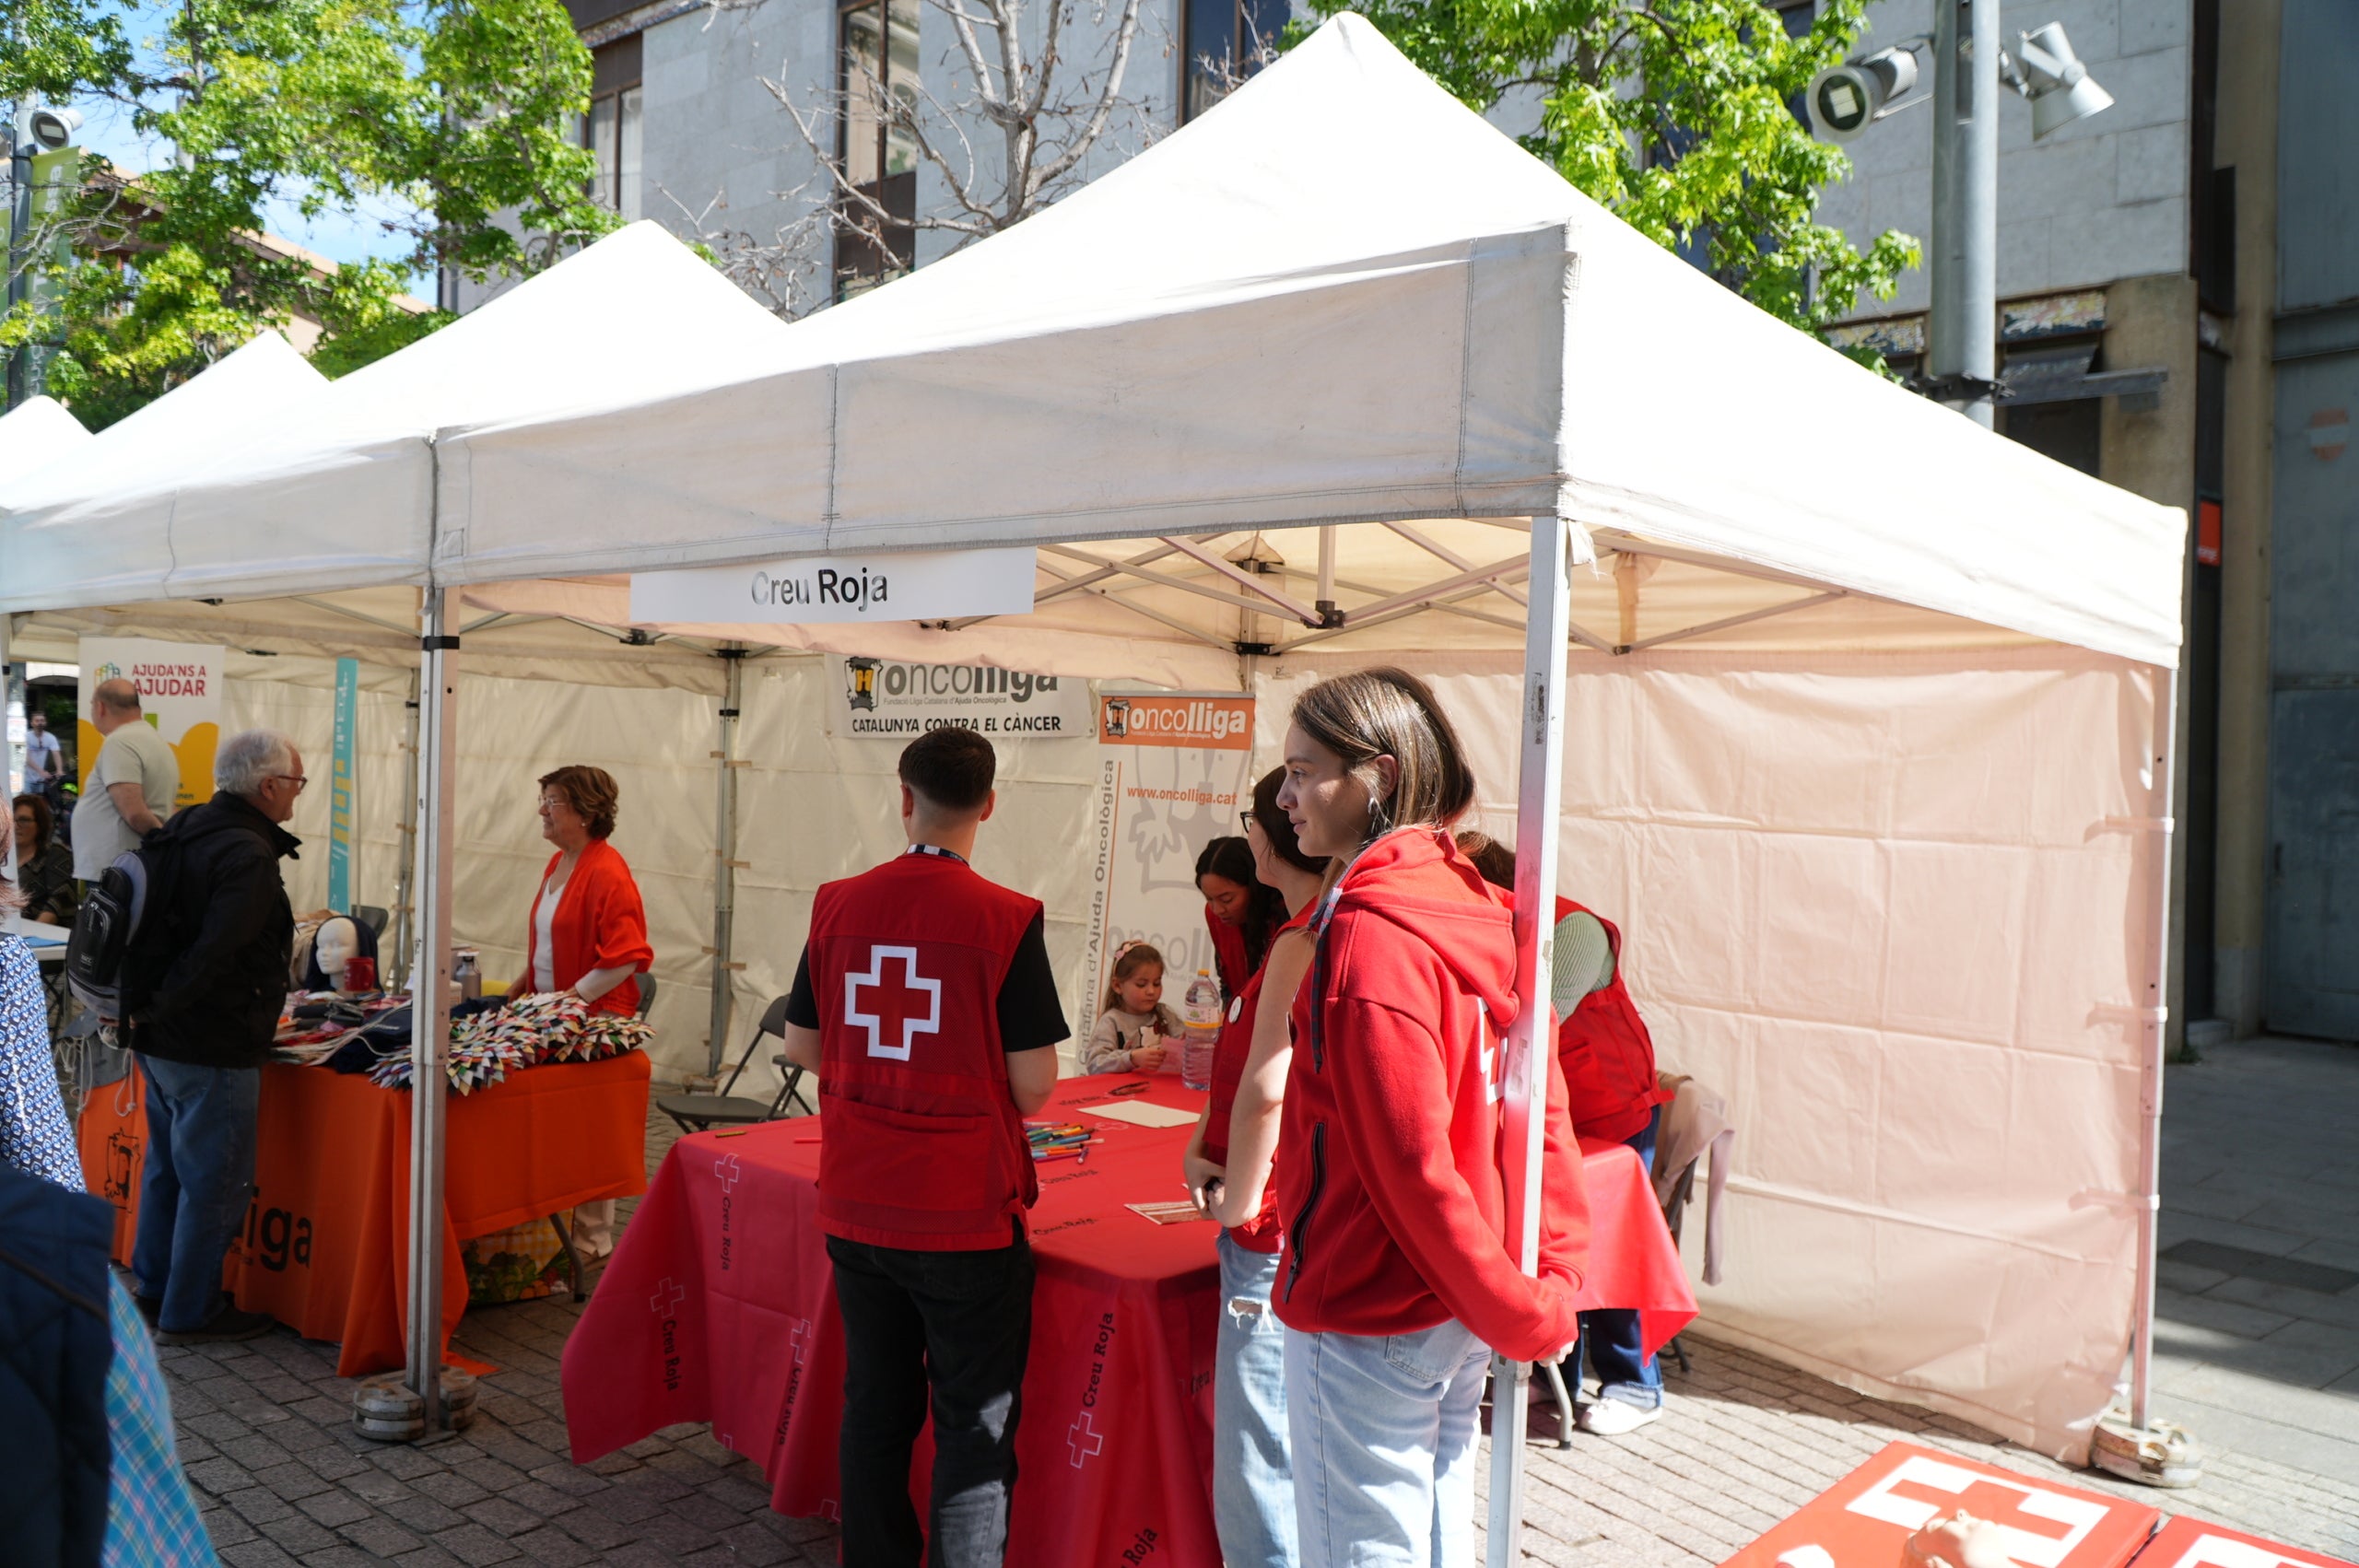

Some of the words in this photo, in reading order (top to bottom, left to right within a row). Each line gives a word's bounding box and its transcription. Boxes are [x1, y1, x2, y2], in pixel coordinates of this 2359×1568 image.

[751, 571, 810, 605] Creu
[818, 567, 887, 612] Roja
[132, 664, 194, 677] AJUDA'NS
[198, 665, 206, 677] A
[134, 679, 205, 696] AJUDAR
[852, 719, 920, 732] CATALUNYA
[984, 718, 998, 731] EL
[1003, 712, 1062, 731] CÀNCER
[1131, 702, 1246, 739] oncolliga
[1127, 786, 1238, 805] www.oncolliga.cat
[1095, 760, 1113, 883] Oncològica
[1088, 890, 1103, 973] d'Ajuda
[722, 1197, 732, 1232] Creu
[721, 1236, 732, 1270] Roja
[663, 1319, 677, 1355] Creu
[663, 1356, 682, 1391] Roja
[1083, 1363, 1103, 1408] Creu
[1094, 1313, 1116, 1357] Roja
[1121, 1527, 1158, 1566] Roja
